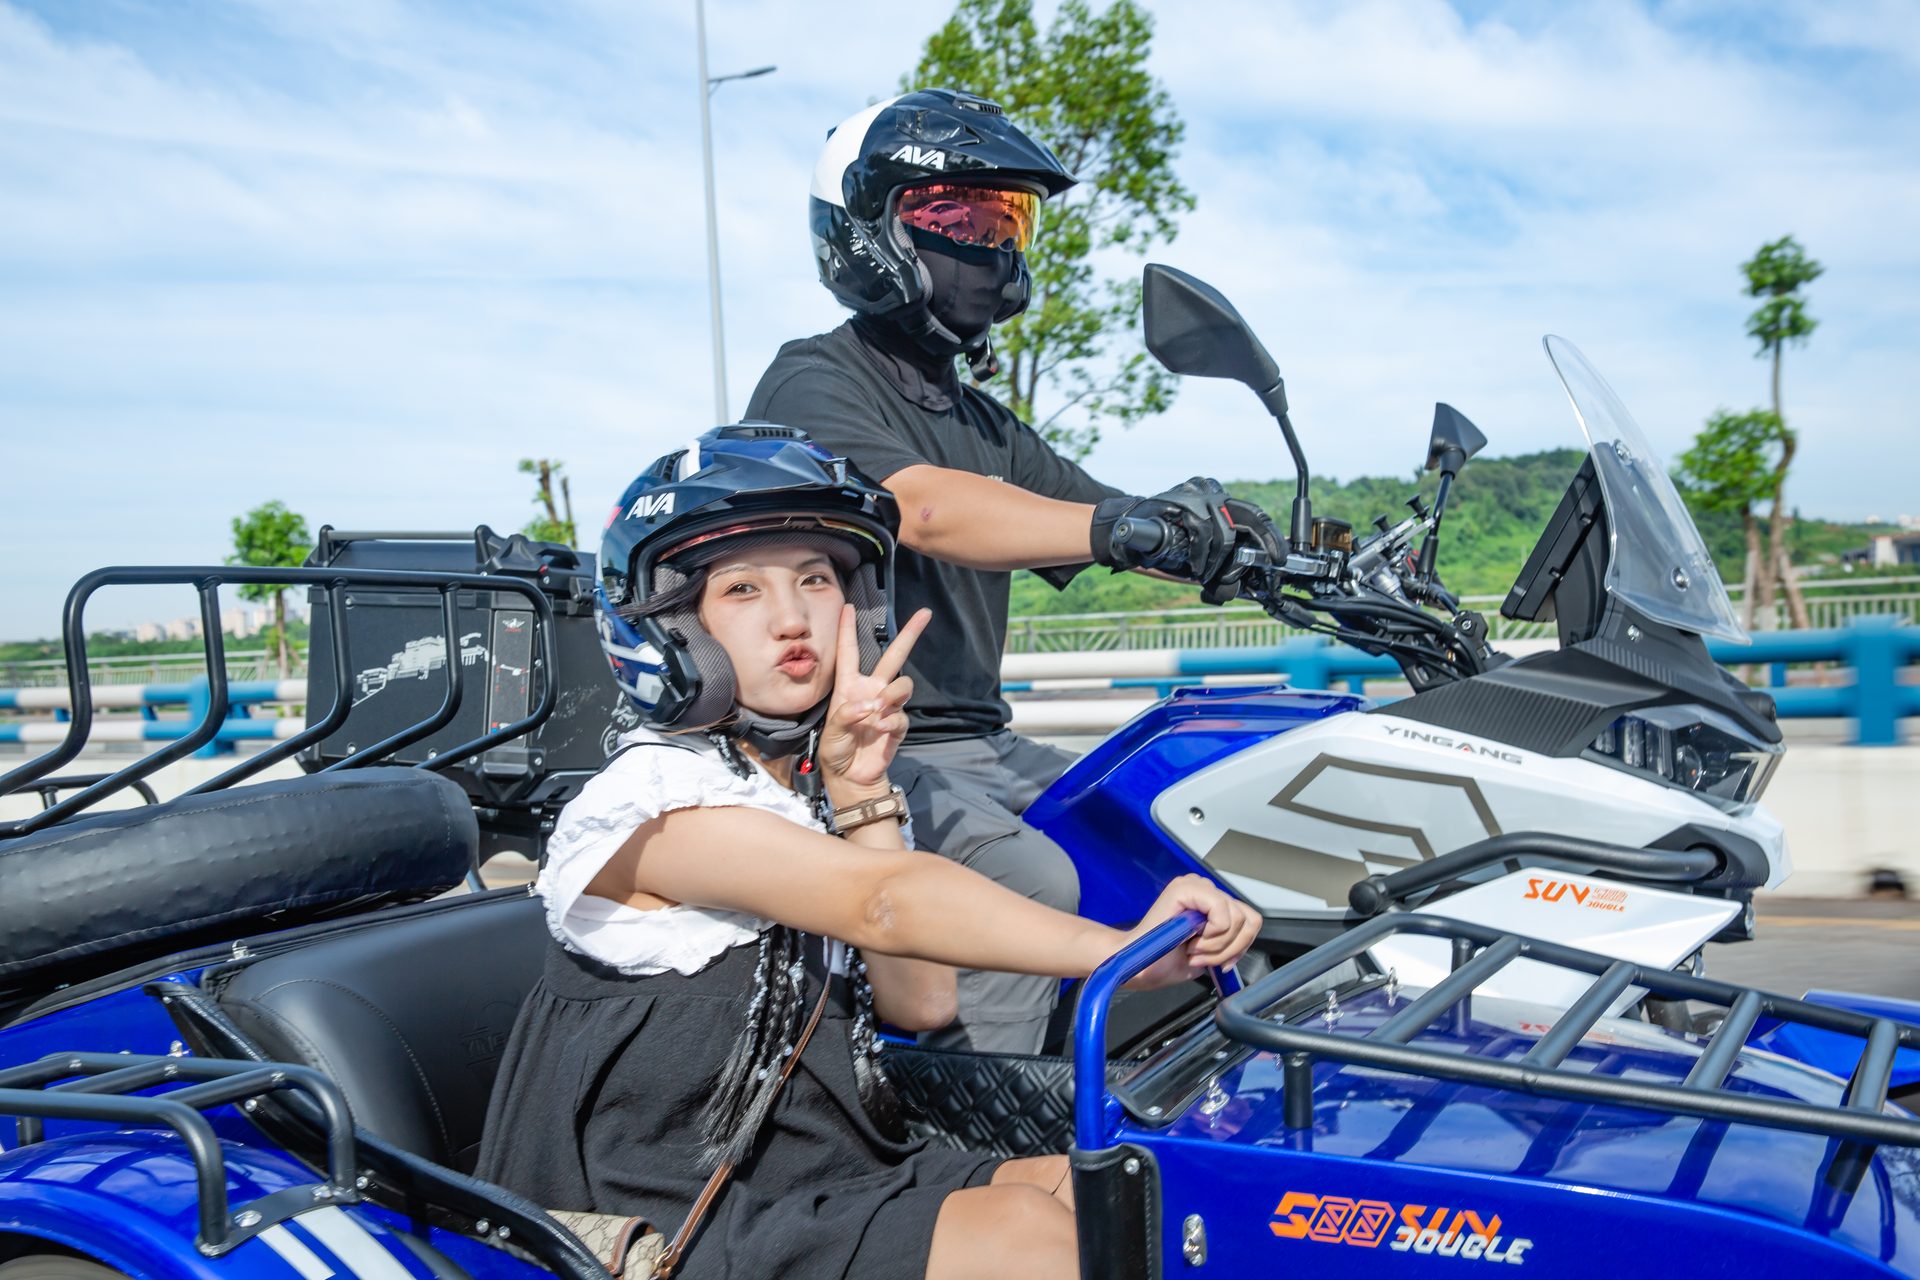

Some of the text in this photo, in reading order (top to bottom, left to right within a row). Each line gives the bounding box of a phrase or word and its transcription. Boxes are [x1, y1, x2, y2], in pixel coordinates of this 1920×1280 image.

[889, 144, 946, 170] AVA
[625, 492, 676, 520] AVA
[1382, 725, 1523, 765] YINGANG
[1523, 878, 1591, 905] SUV
[1268, 1190, 1396, 1248] 500
[1389, 1225, 1534, 1265] DOUBLE
